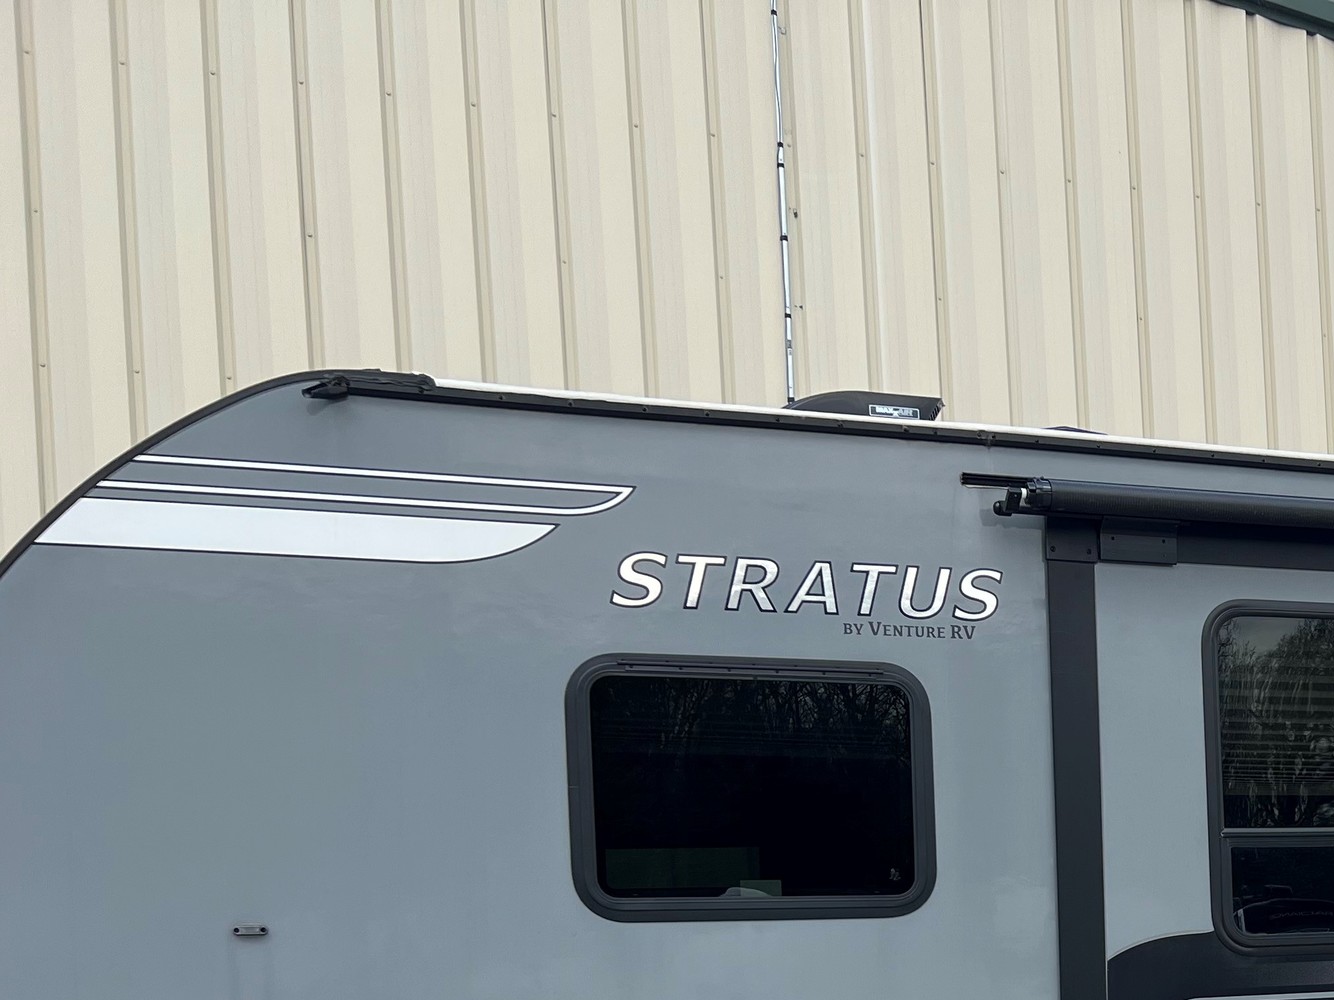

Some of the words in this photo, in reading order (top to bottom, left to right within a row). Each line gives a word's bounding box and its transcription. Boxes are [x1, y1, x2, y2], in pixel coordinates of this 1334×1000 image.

[609, 551, 1004, 622] STRATUS
[842, 623, 864, 636] BY
[950, 625, 976, 640] RV
